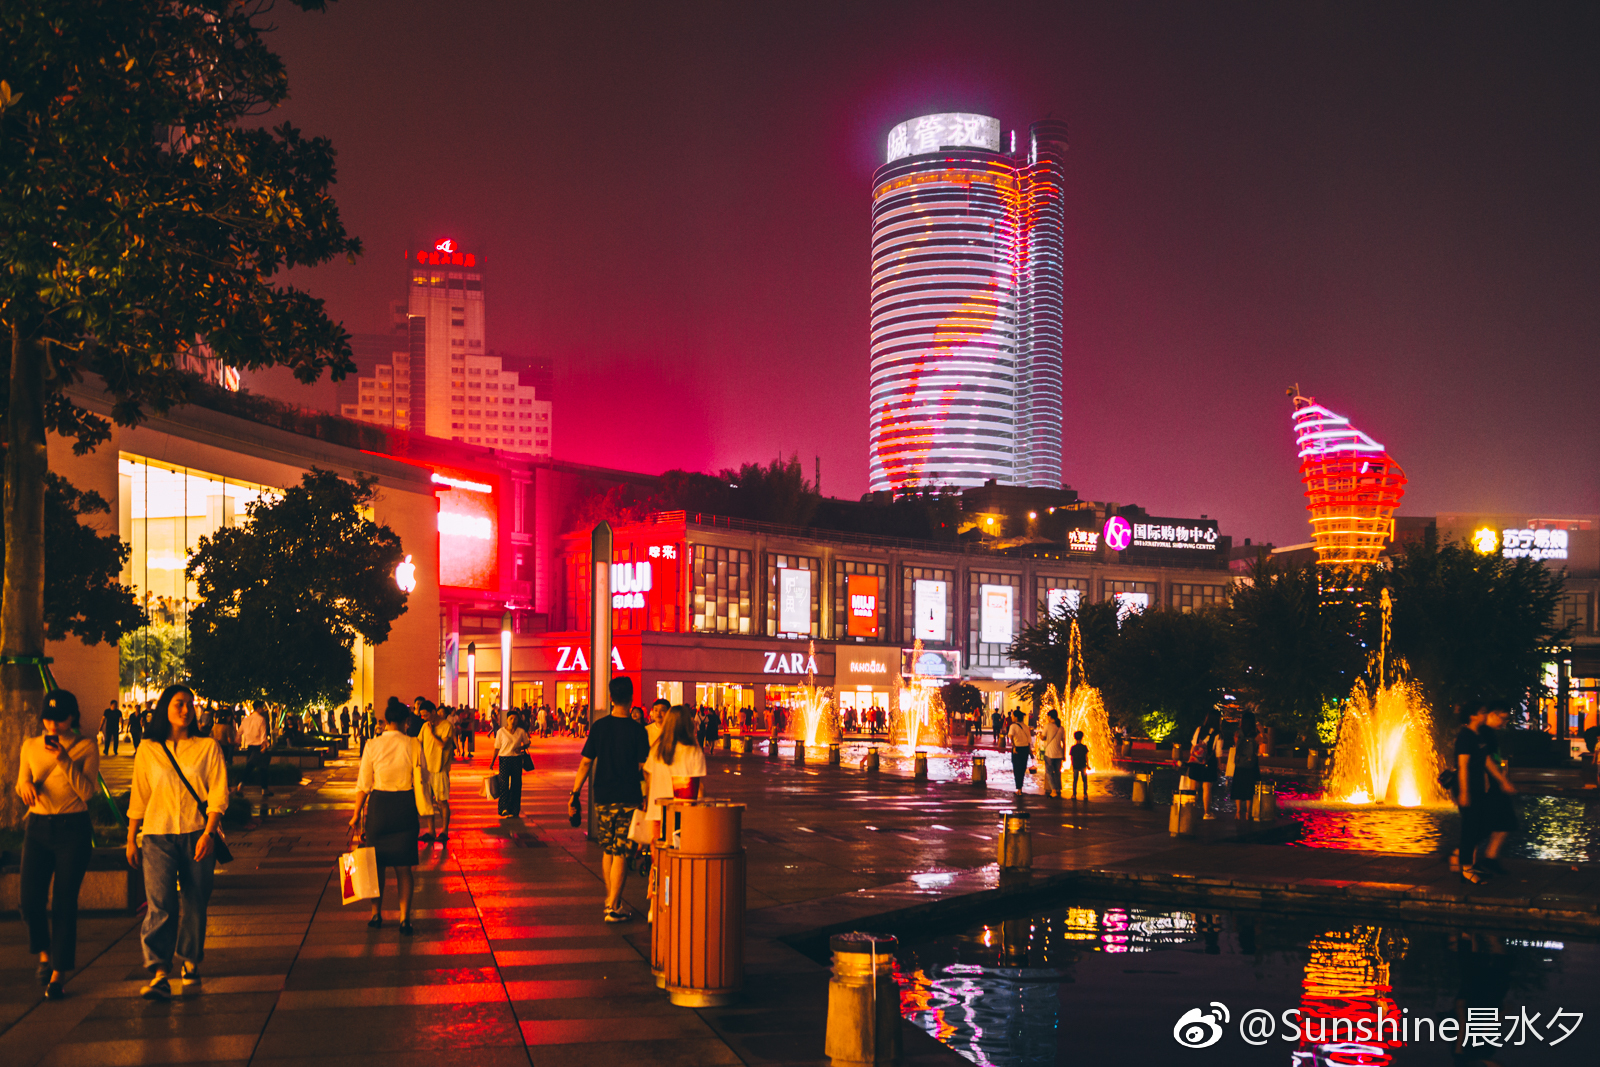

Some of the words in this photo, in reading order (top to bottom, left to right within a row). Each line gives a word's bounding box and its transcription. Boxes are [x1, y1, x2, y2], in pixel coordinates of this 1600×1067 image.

[1133, 523, 1218, 543] 国际购物中心
[1502, 529, 1568, 548] 苏宁易购
[611, 562, 652, 592] UJI
[612, 593, 645, 609] 印良品
[851, 595, 875, 610] MUJI
[556, 646, 625, 671] ZAA
[763, 652, 819, 674] ZARA
[850, 660, 887, 673] PANDORA
